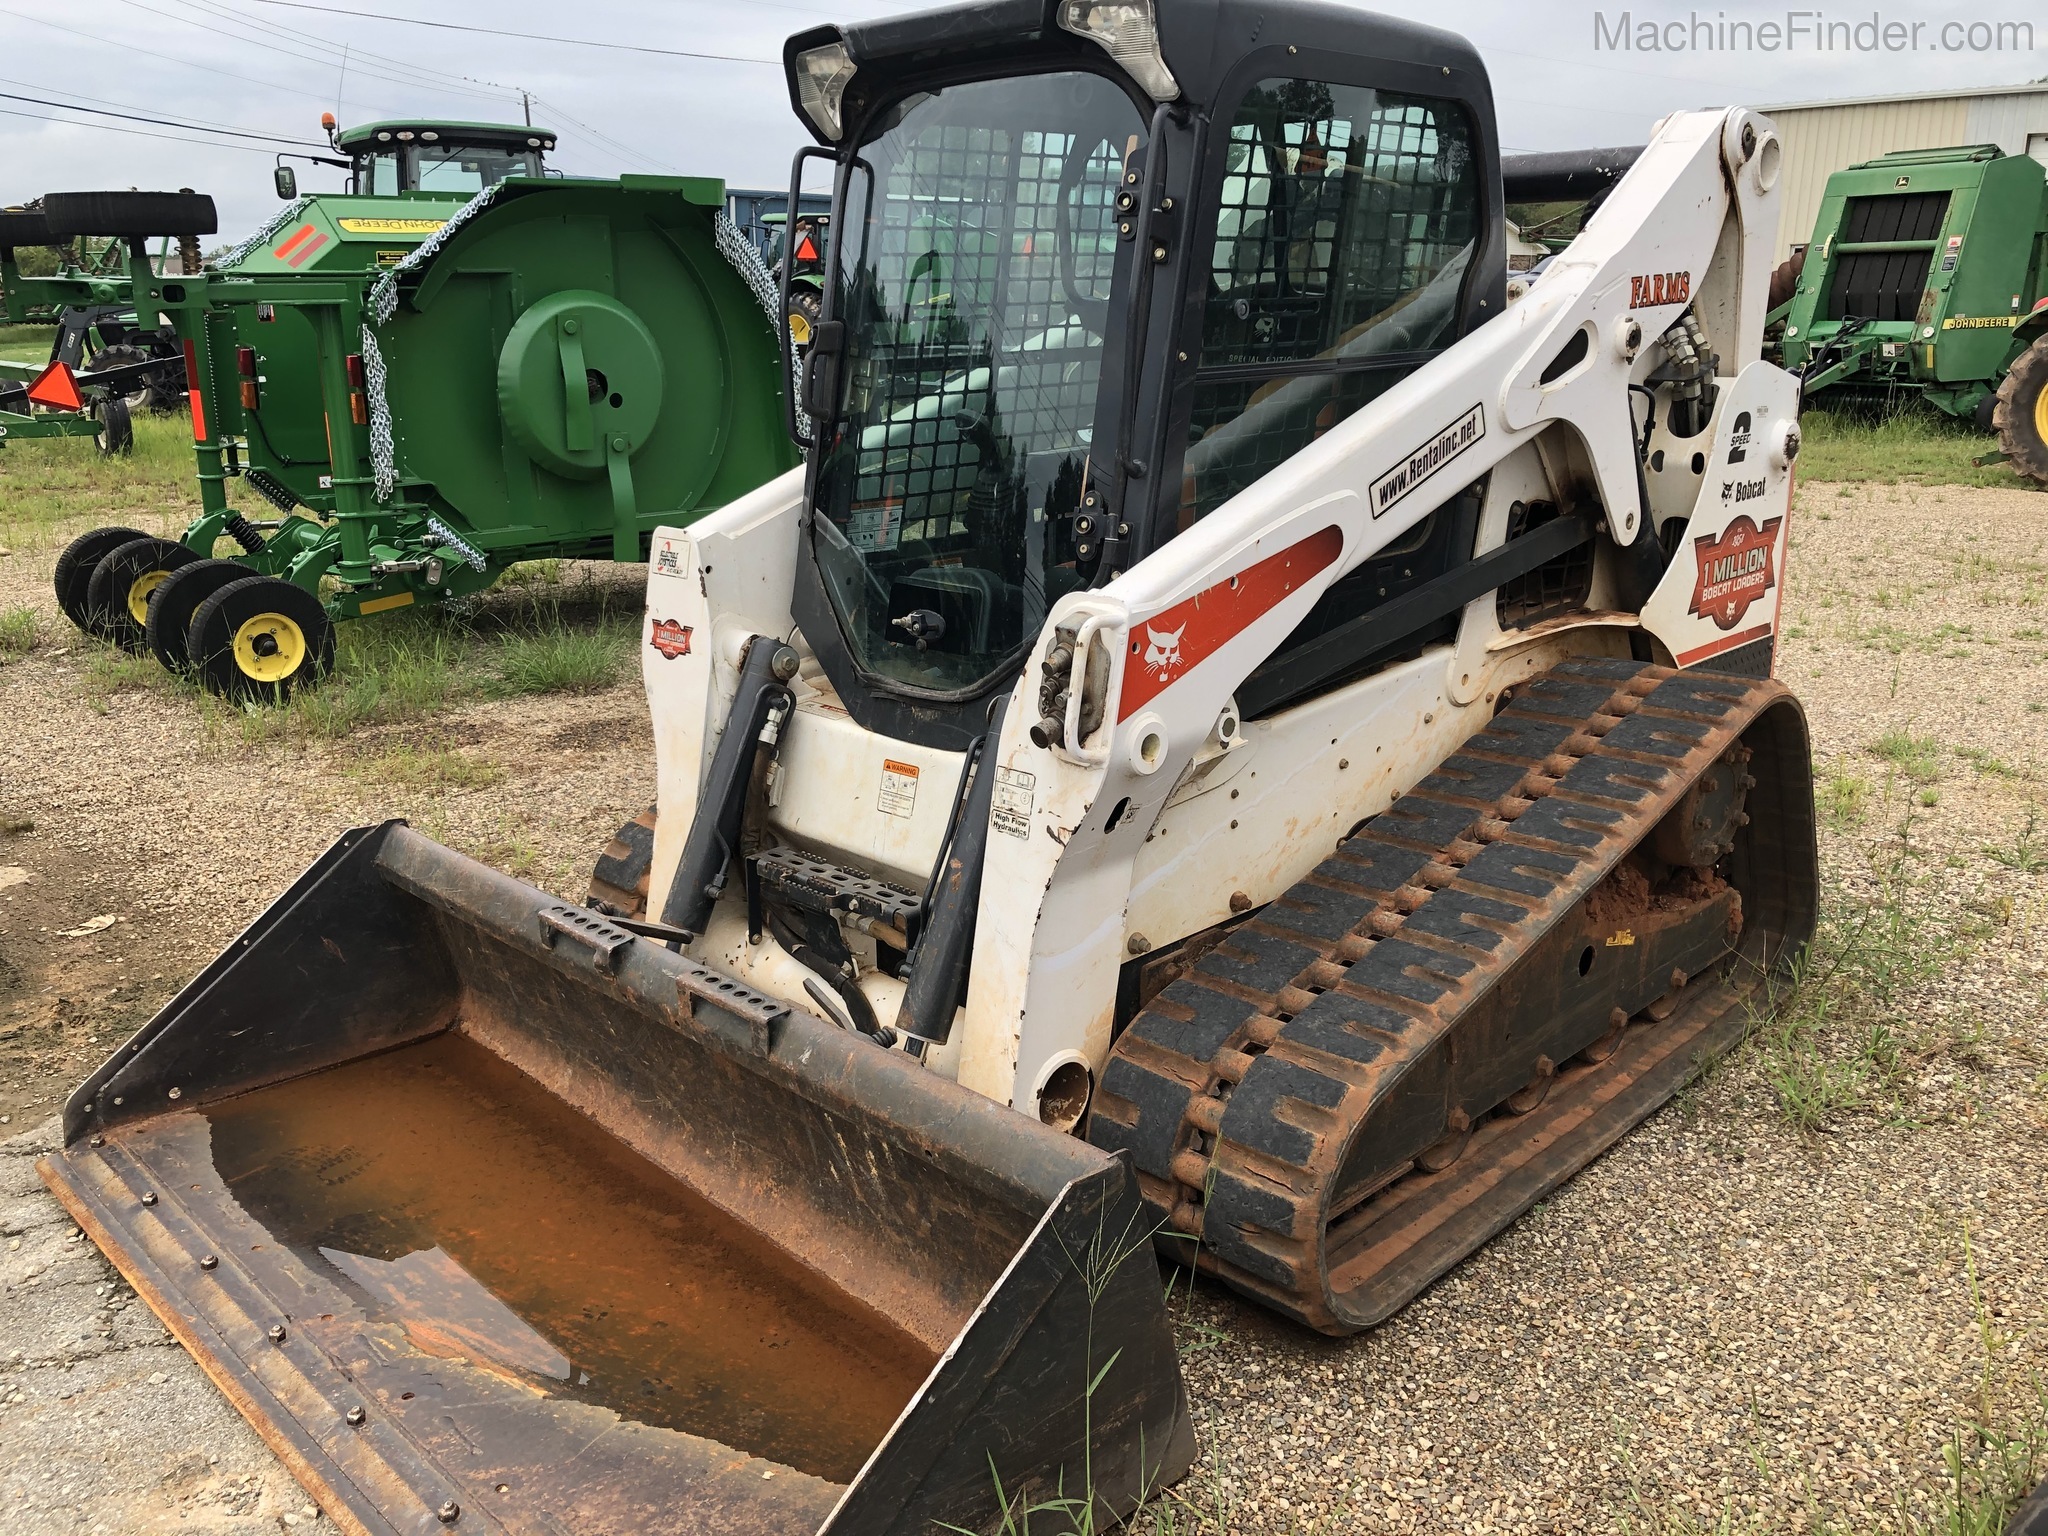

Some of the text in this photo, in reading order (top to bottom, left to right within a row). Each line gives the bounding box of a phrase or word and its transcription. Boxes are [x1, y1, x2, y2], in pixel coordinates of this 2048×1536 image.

[353, 220, 441, 230] JOHN DEERE
[1629, 271, 1690, 309] FARMS
[1949, 317, 2009, 329] JOHN DEERE
[1727, 411, 1751, 465] 2
[1730, 433, 1751, 447] SPEED
[1379, 413, 1476, 507] www.Rentalinc.net
[1735, 476, 1766, 503] Bobcat
[1703, 544, 1769, 588] 1 MILLION
[1702, 571, 1765, 602] BOBCAT LOADERS
[891, 763, 917, 776] WARNING
[993, 820, 1027, 837] Hydraulics
[995, 812, 1028, 828] High Flow
